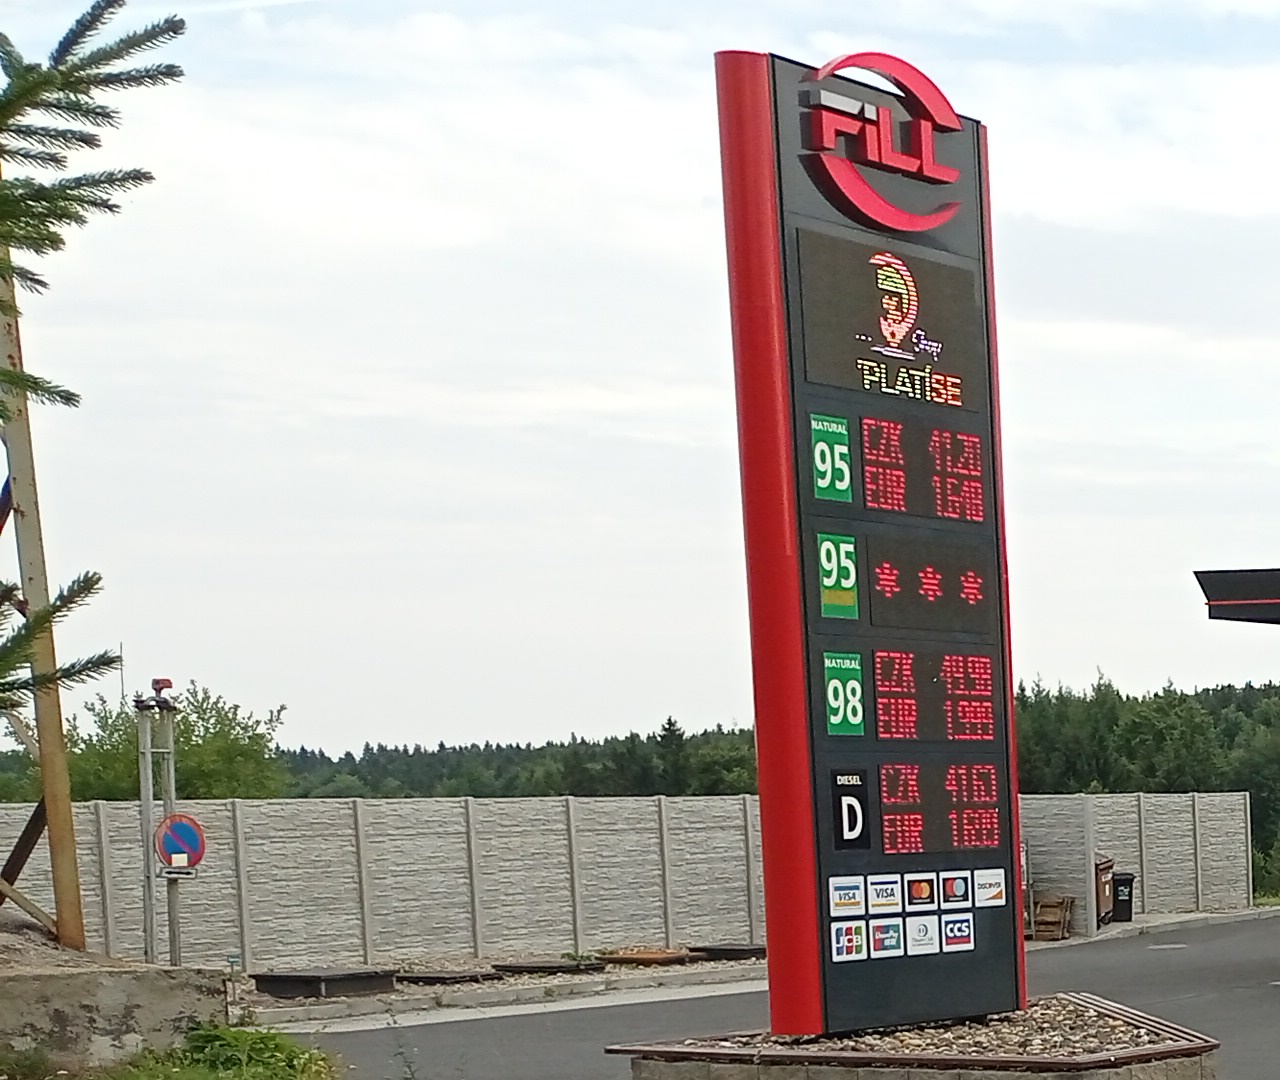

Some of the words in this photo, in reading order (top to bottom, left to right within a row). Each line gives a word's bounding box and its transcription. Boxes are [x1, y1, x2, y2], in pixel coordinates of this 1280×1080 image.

[811, 420, 848, 434] NATURAL
[863, 418, 903, 465] CZK
[815, 442, 850, 490] 95
[865, 466, 906, 511] EUR
[820, 541, 856, 588] 95
[825, 658, 861, 670] NATURAL
[876, 651, 916, 693] CZK
[827, 679, 863, 725] 98
[836, 775, 862, 785] DIESEL
[841, 796, 863, 840] D
[839, 891, 857, 901] VISA
[874, 887, 896, 900] VISA
[946, 922, 970, 938] CCS
